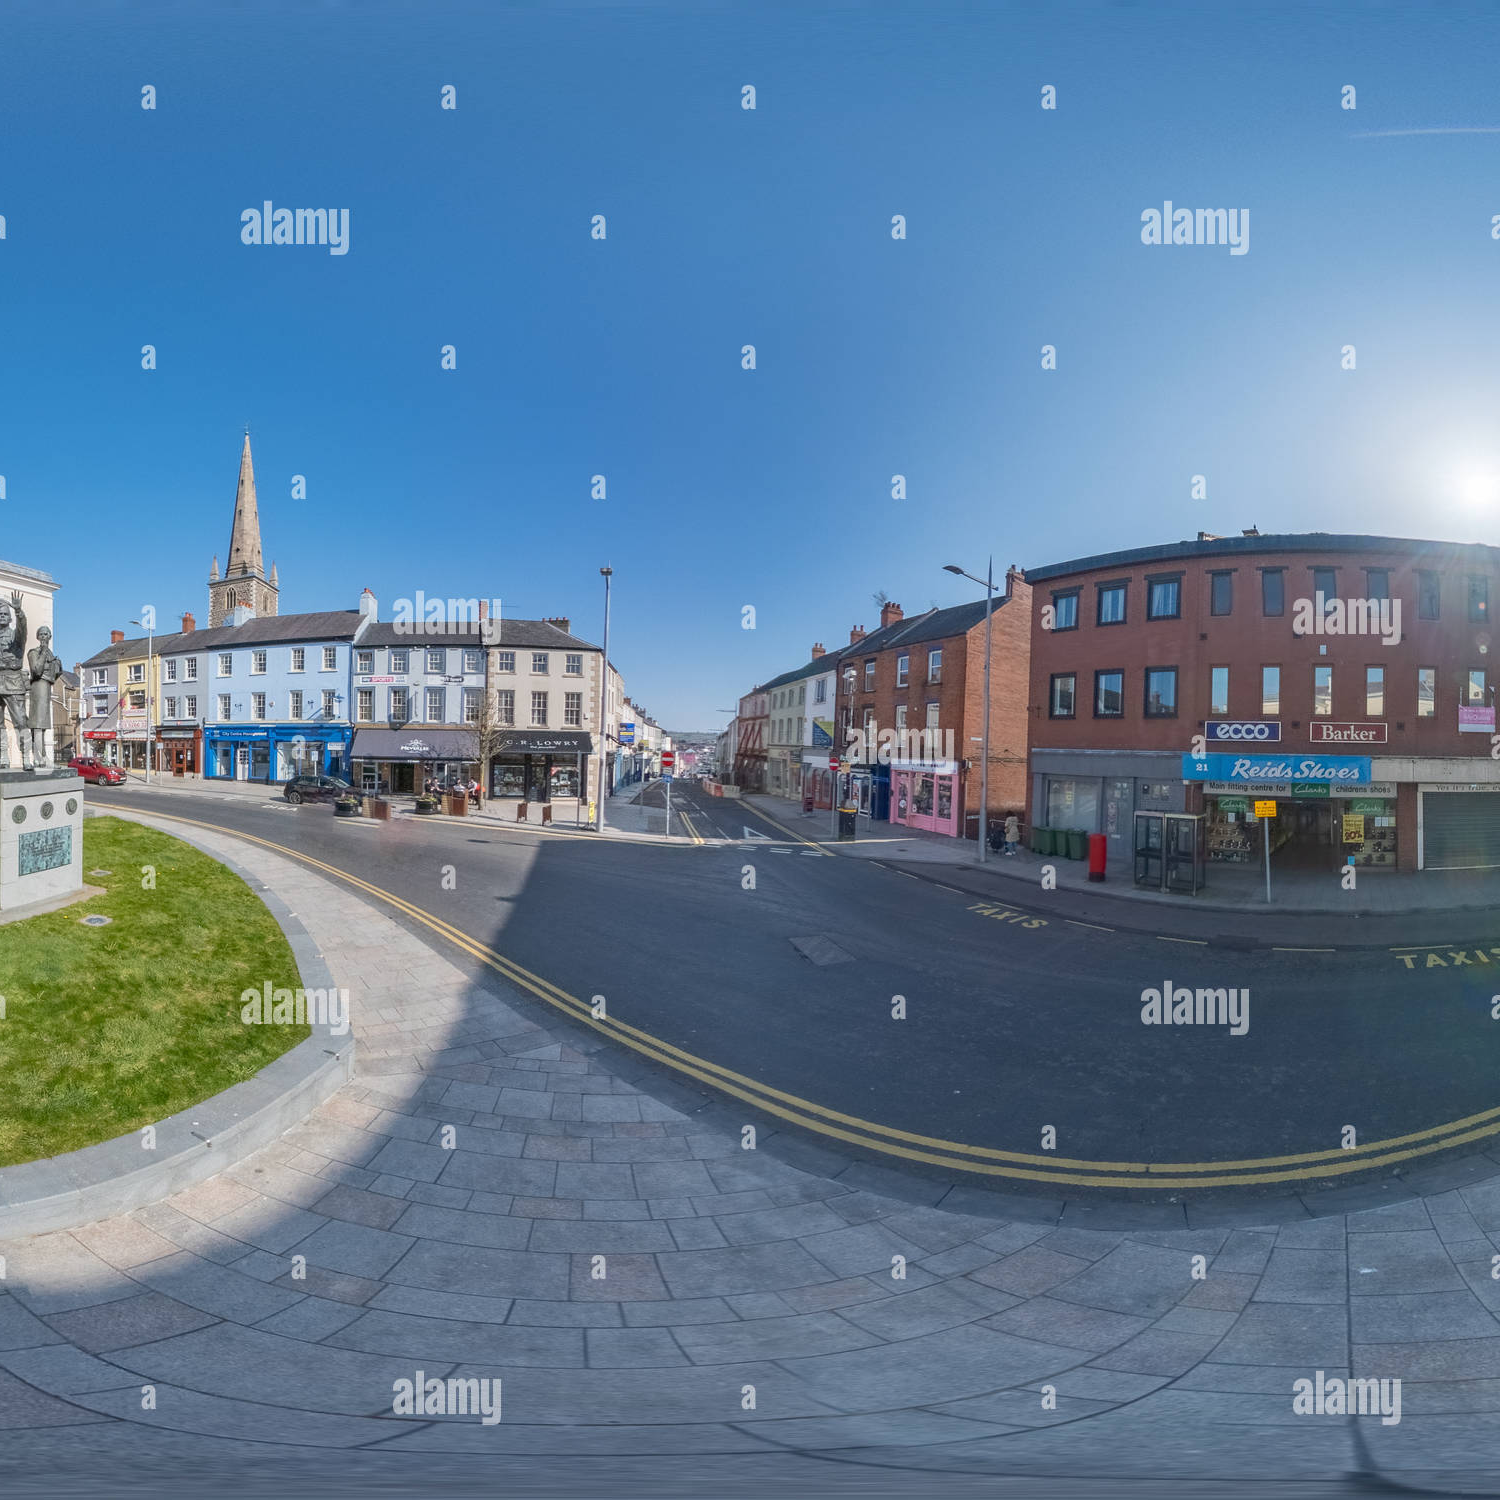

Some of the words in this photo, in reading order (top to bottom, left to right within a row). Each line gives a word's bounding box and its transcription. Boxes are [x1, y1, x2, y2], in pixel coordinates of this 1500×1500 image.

[1216, 723, 1269, 739] ecco
[1321, 724, 1377, 741] Barker
[1195, 762, 1209, 772] 21
[1231, 758, 1293, 779] Reids
[1294, 760, 1359, 780] Shoes
[1209, 782, 1226, 791] Main
[1227, 782, 1249, 793] fitting
[1250, 783, 1274, 792] centre
[1275, 783, 1287, 792] for
[1335, 785, 1368, 793] childrens
[1370, 785, 1391, 794] shoes
[966, 902, 1049, 929] TAXIS
